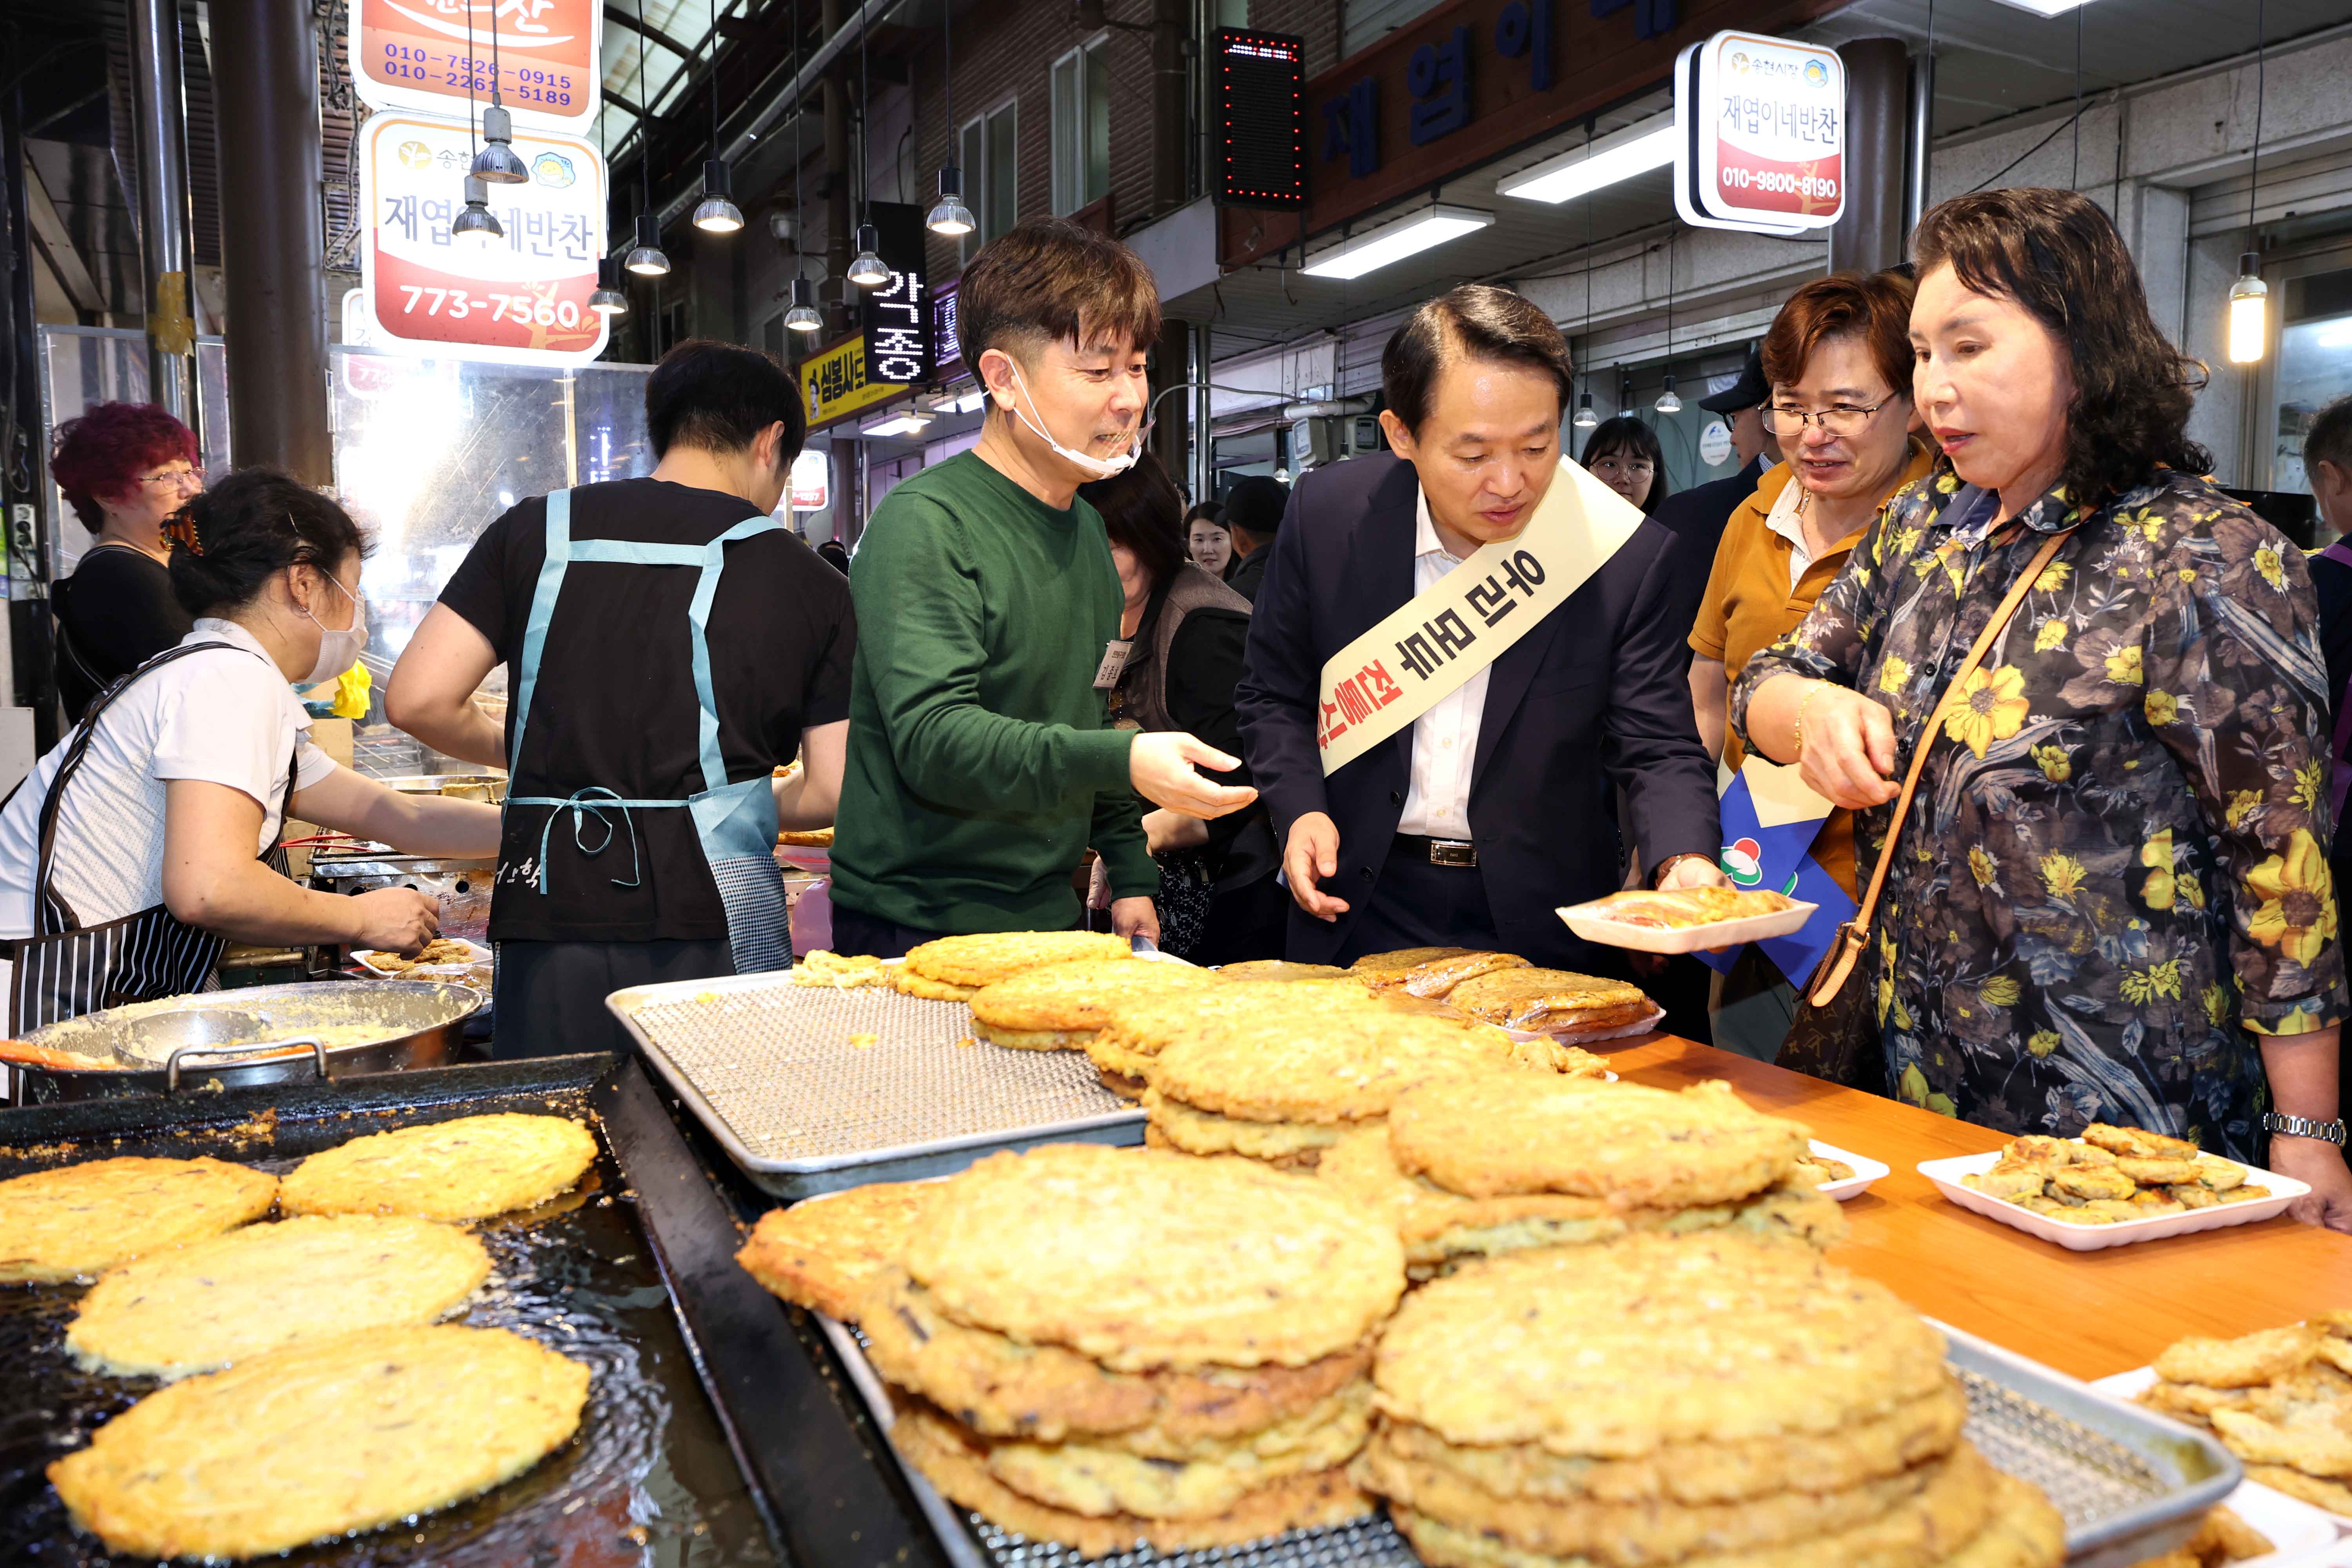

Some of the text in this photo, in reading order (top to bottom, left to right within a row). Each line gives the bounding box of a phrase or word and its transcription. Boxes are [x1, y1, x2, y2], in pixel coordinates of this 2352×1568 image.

[385, 44, 571, 89] 010-7526-0915
[385, 62, 570, 106] 010-2261-5189
[1751, 59, 1799, 79] 송현시장
[1723, 95, 1838, 144] 재엽이네반찬
[1722, 167, 1837, 198] 010-9800-8190
[383, 195, 593, 261] 재엽네반찬
[399, 285, 579, 328] 773-7560
[1465, 550, 1545, 628] 우리
[1395, 607, 1477, 681] 모두
